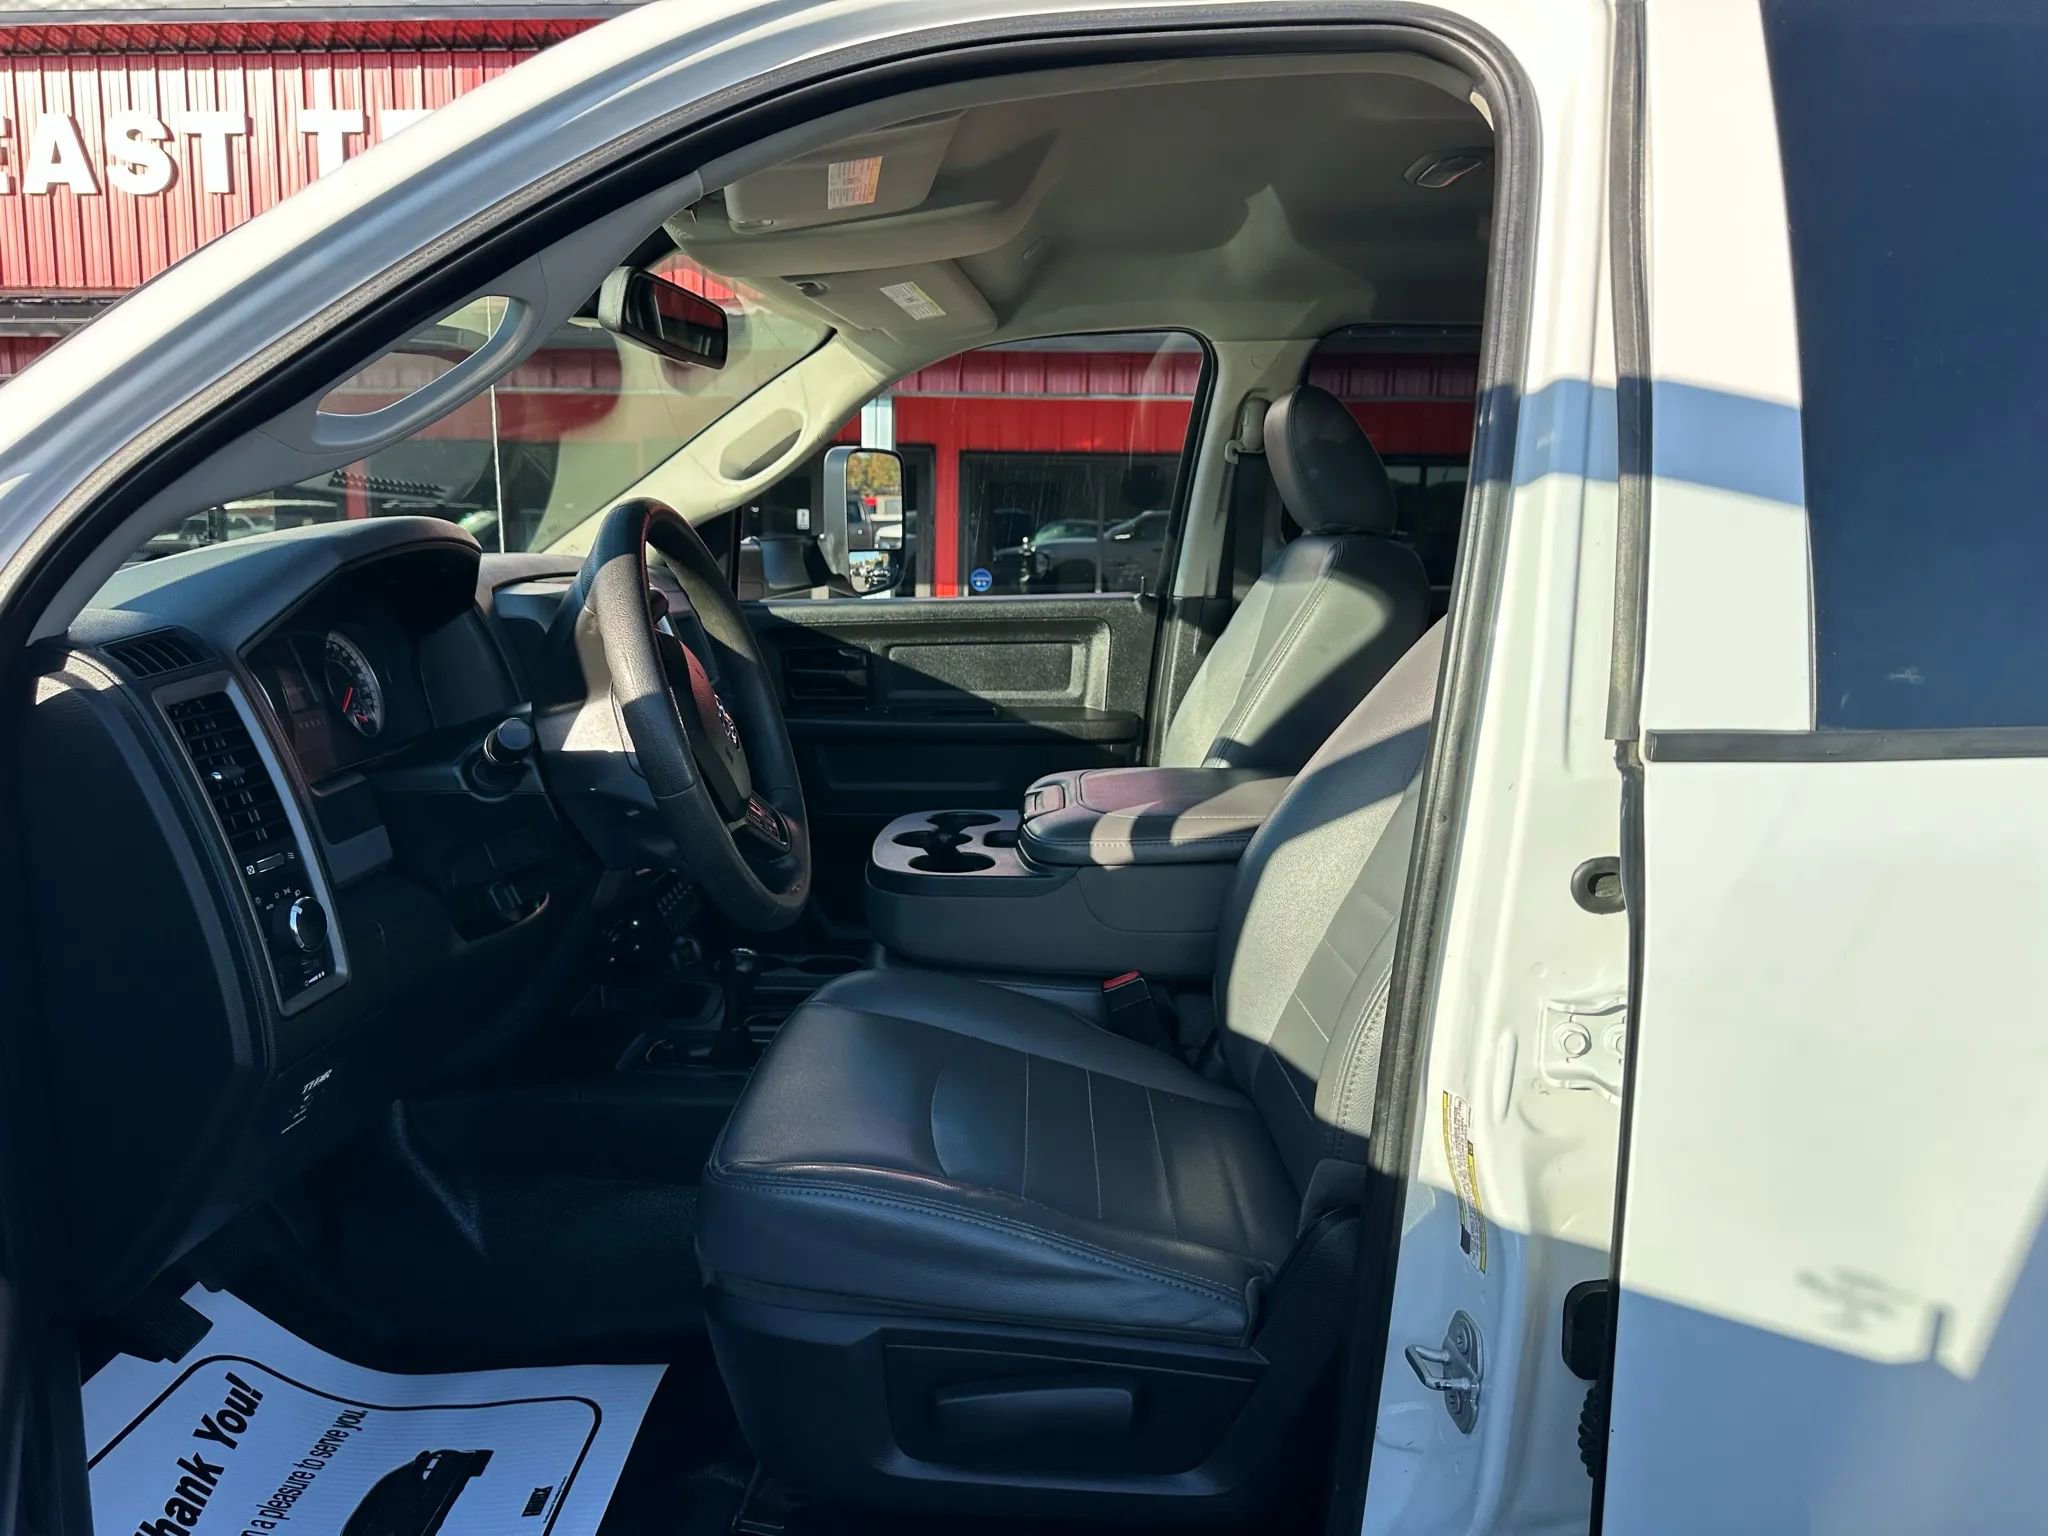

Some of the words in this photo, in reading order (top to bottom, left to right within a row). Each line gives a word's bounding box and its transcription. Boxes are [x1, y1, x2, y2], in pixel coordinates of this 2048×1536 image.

[0, 110, 247, 195] AST
[332, 1409, 369, 1431] you.
[134, 1451, 224, 1536] hank
[192, 1372, 264, 1450] You!
[309, 1429, 349, 1459] serve
[292, 1459, 326, 1470] to
[256, 1471, 316, 1520] pleasure
[251, 1519, 277, 1530] a
